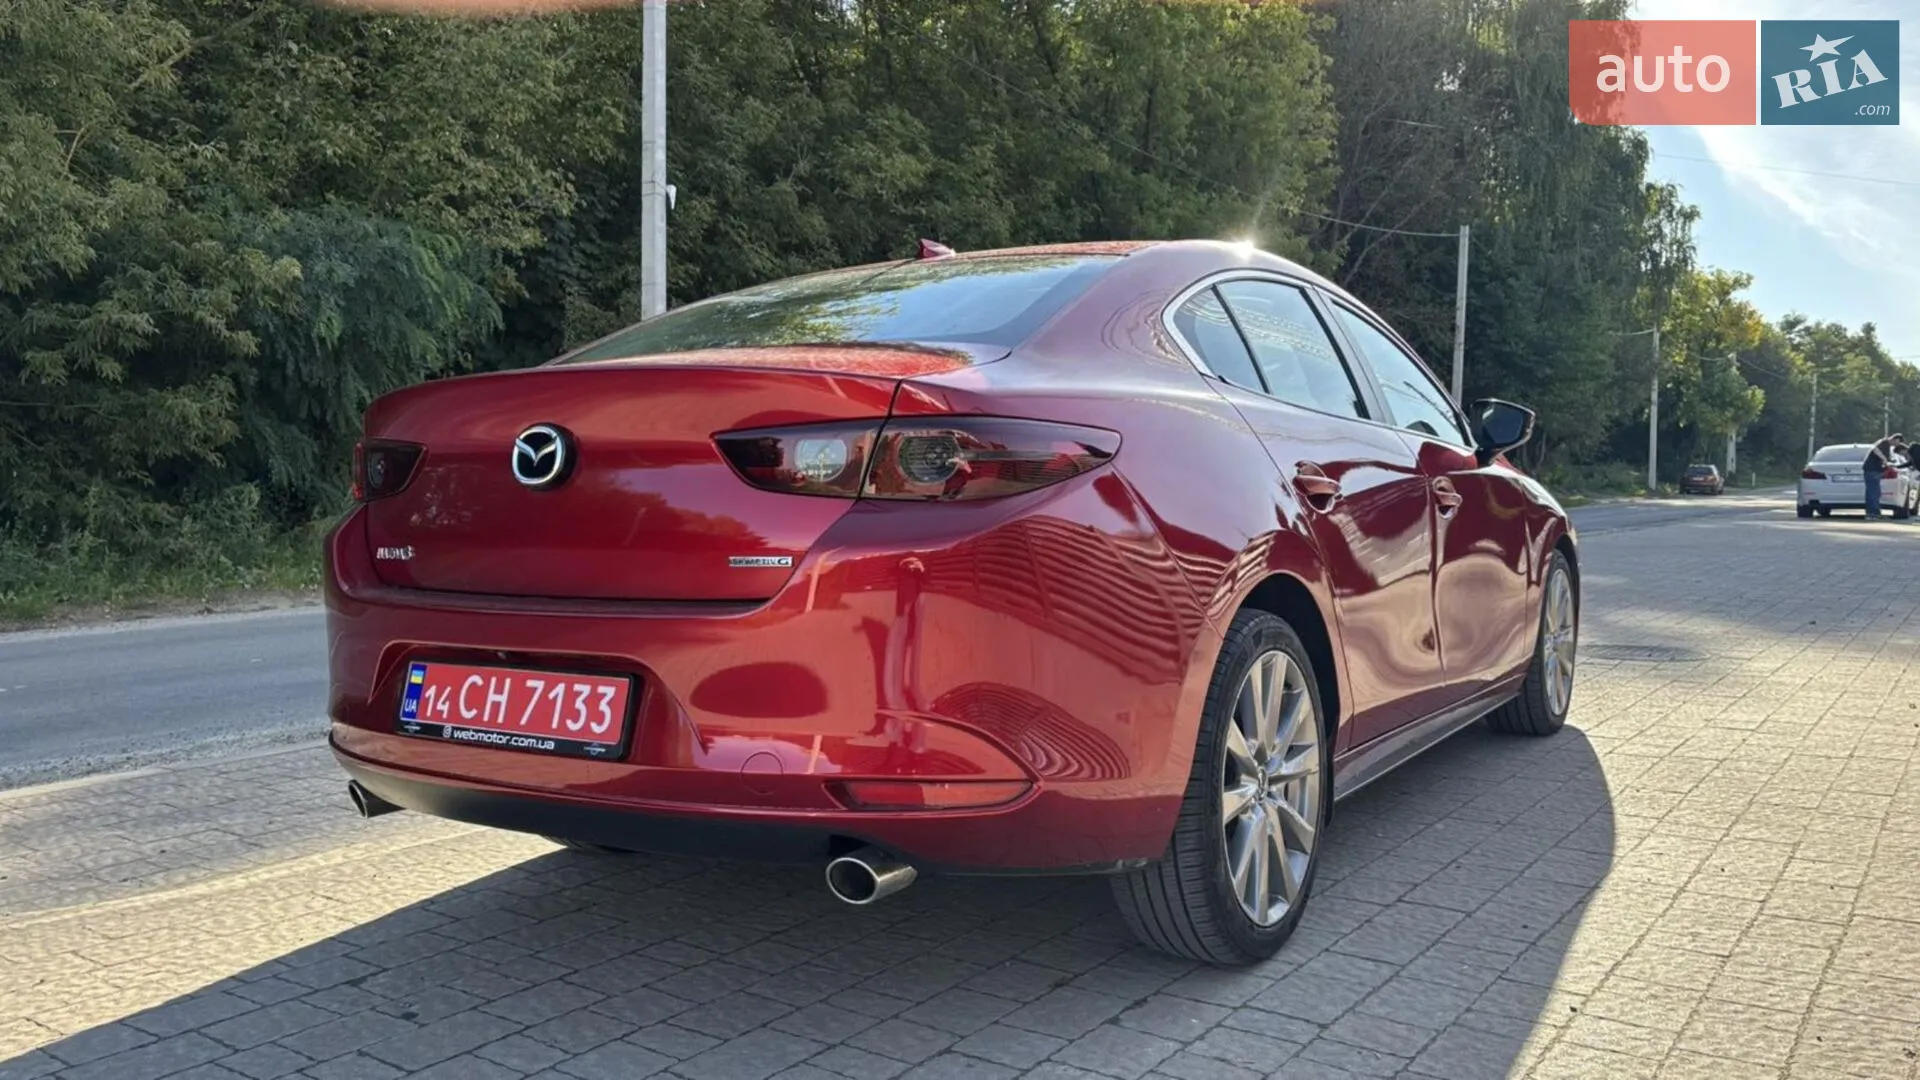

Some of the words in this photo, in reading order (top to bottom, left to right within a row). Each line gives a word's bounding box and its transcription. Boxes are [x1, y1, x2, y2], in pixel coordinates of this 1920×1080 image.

[404, 699, 417, 713] UA
[424, 684, 452, 719] 14
[459, 674, 512, 724] CH
[519, 679, 617, 734] 7133
[453, 728, 555, 750] webmotor.com.ua
